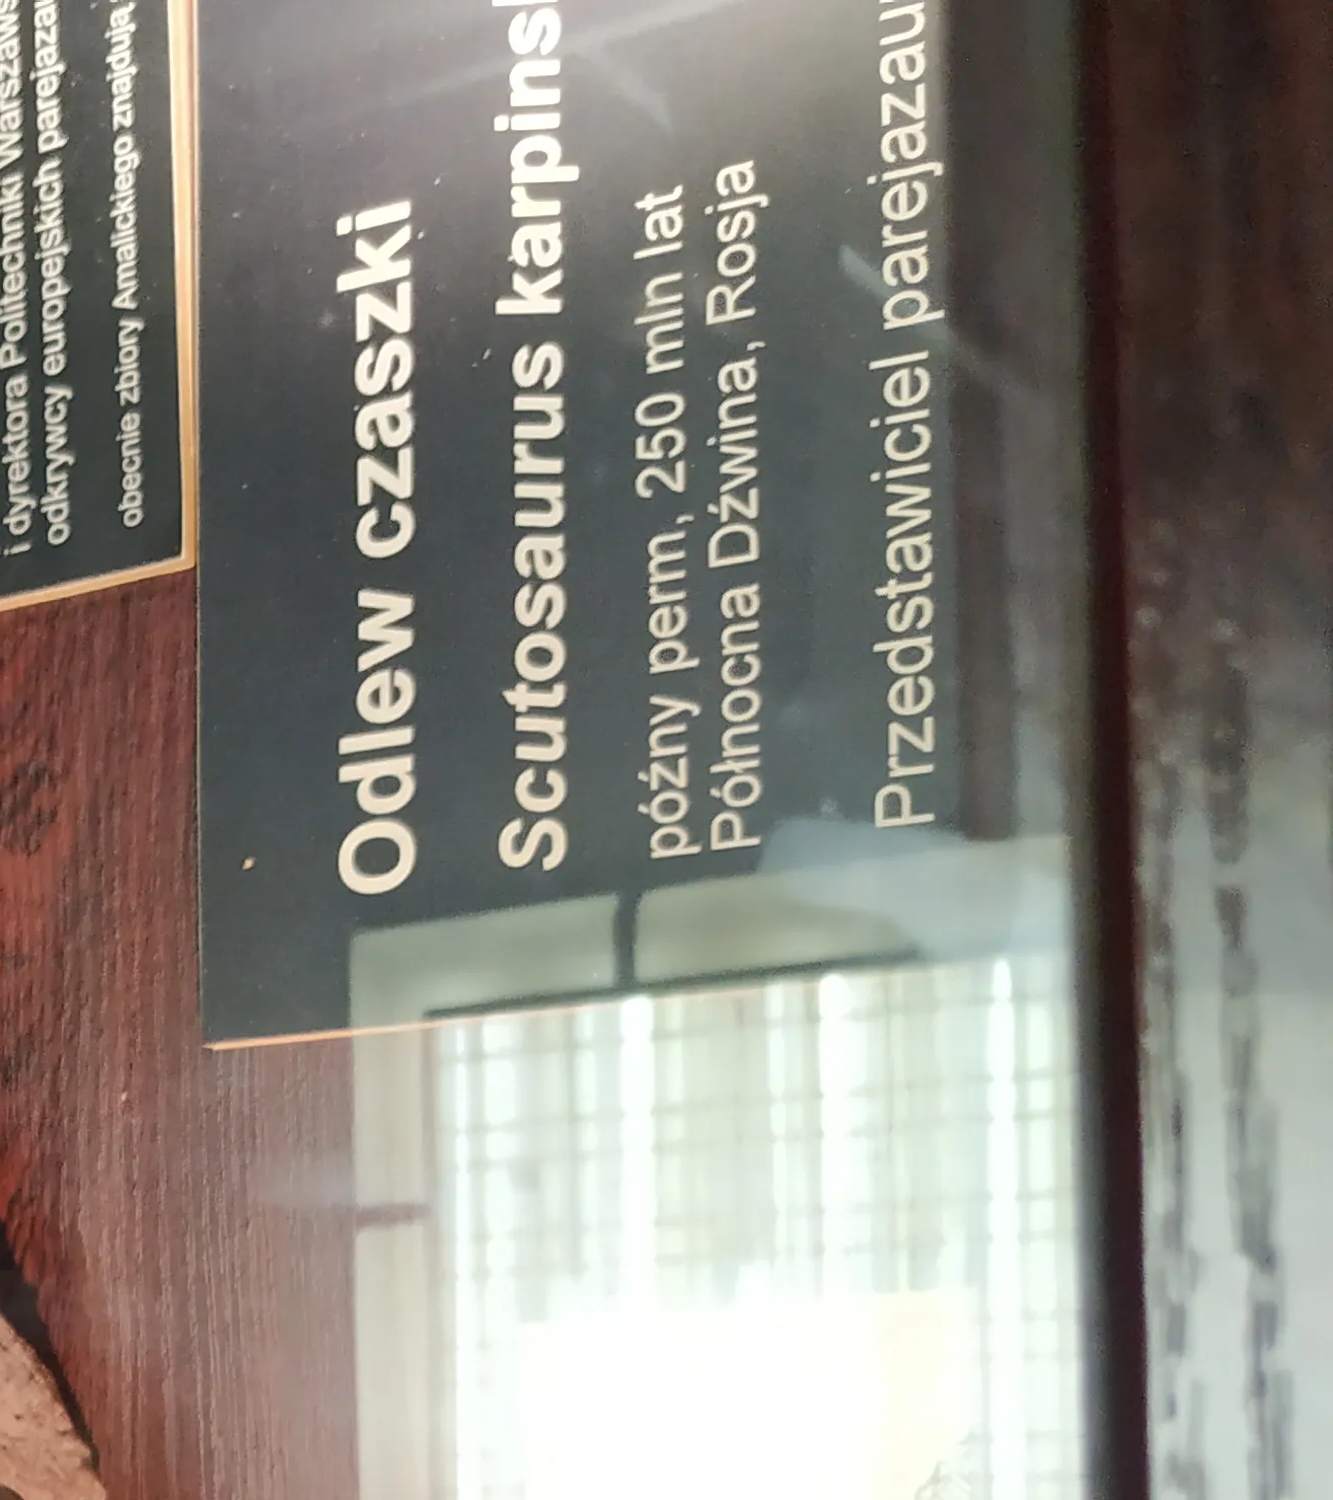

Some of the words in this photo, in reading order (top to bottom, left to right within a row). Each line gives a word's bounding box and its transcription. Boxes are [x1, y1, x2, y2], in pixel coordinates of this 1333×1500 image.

[28, 0, 69, 154] parejaza
[104, 1, 139, 131] znajdują
[109, 133, 142, 310] Amalickiego
[492, 0, 581, 315] karpins
[632, 184, 684, 260] lat
[866, 0, 946, 330] parejazau
[32, 158, 73, 377] europejskich
[632, 272, 686, 375] mln
[703, 159, 770, 326] Rosja
[113, 318, 145, 406] zbiory
[335, 198, 417, 559] czaszki
[1, 374, 38, 536] dyrektora
[39, 384, 74, 546] odkrywcy
[115, 411, 144, 527] obecnie
[634, 391, 686, 499] 250
[704, 340, 766, 569] Dźwina,
[2, 542, 33, 556] i
[496, 340, 569, 872] Scutosaurus
[643, 514, 700, 675] perm,
[869, 349, 936, 829] Przedstawiciel
[337, 587, 418, 896] Odlew
[637, 695, 703, 859] późny
[709, 582, 762, 851] Północna
